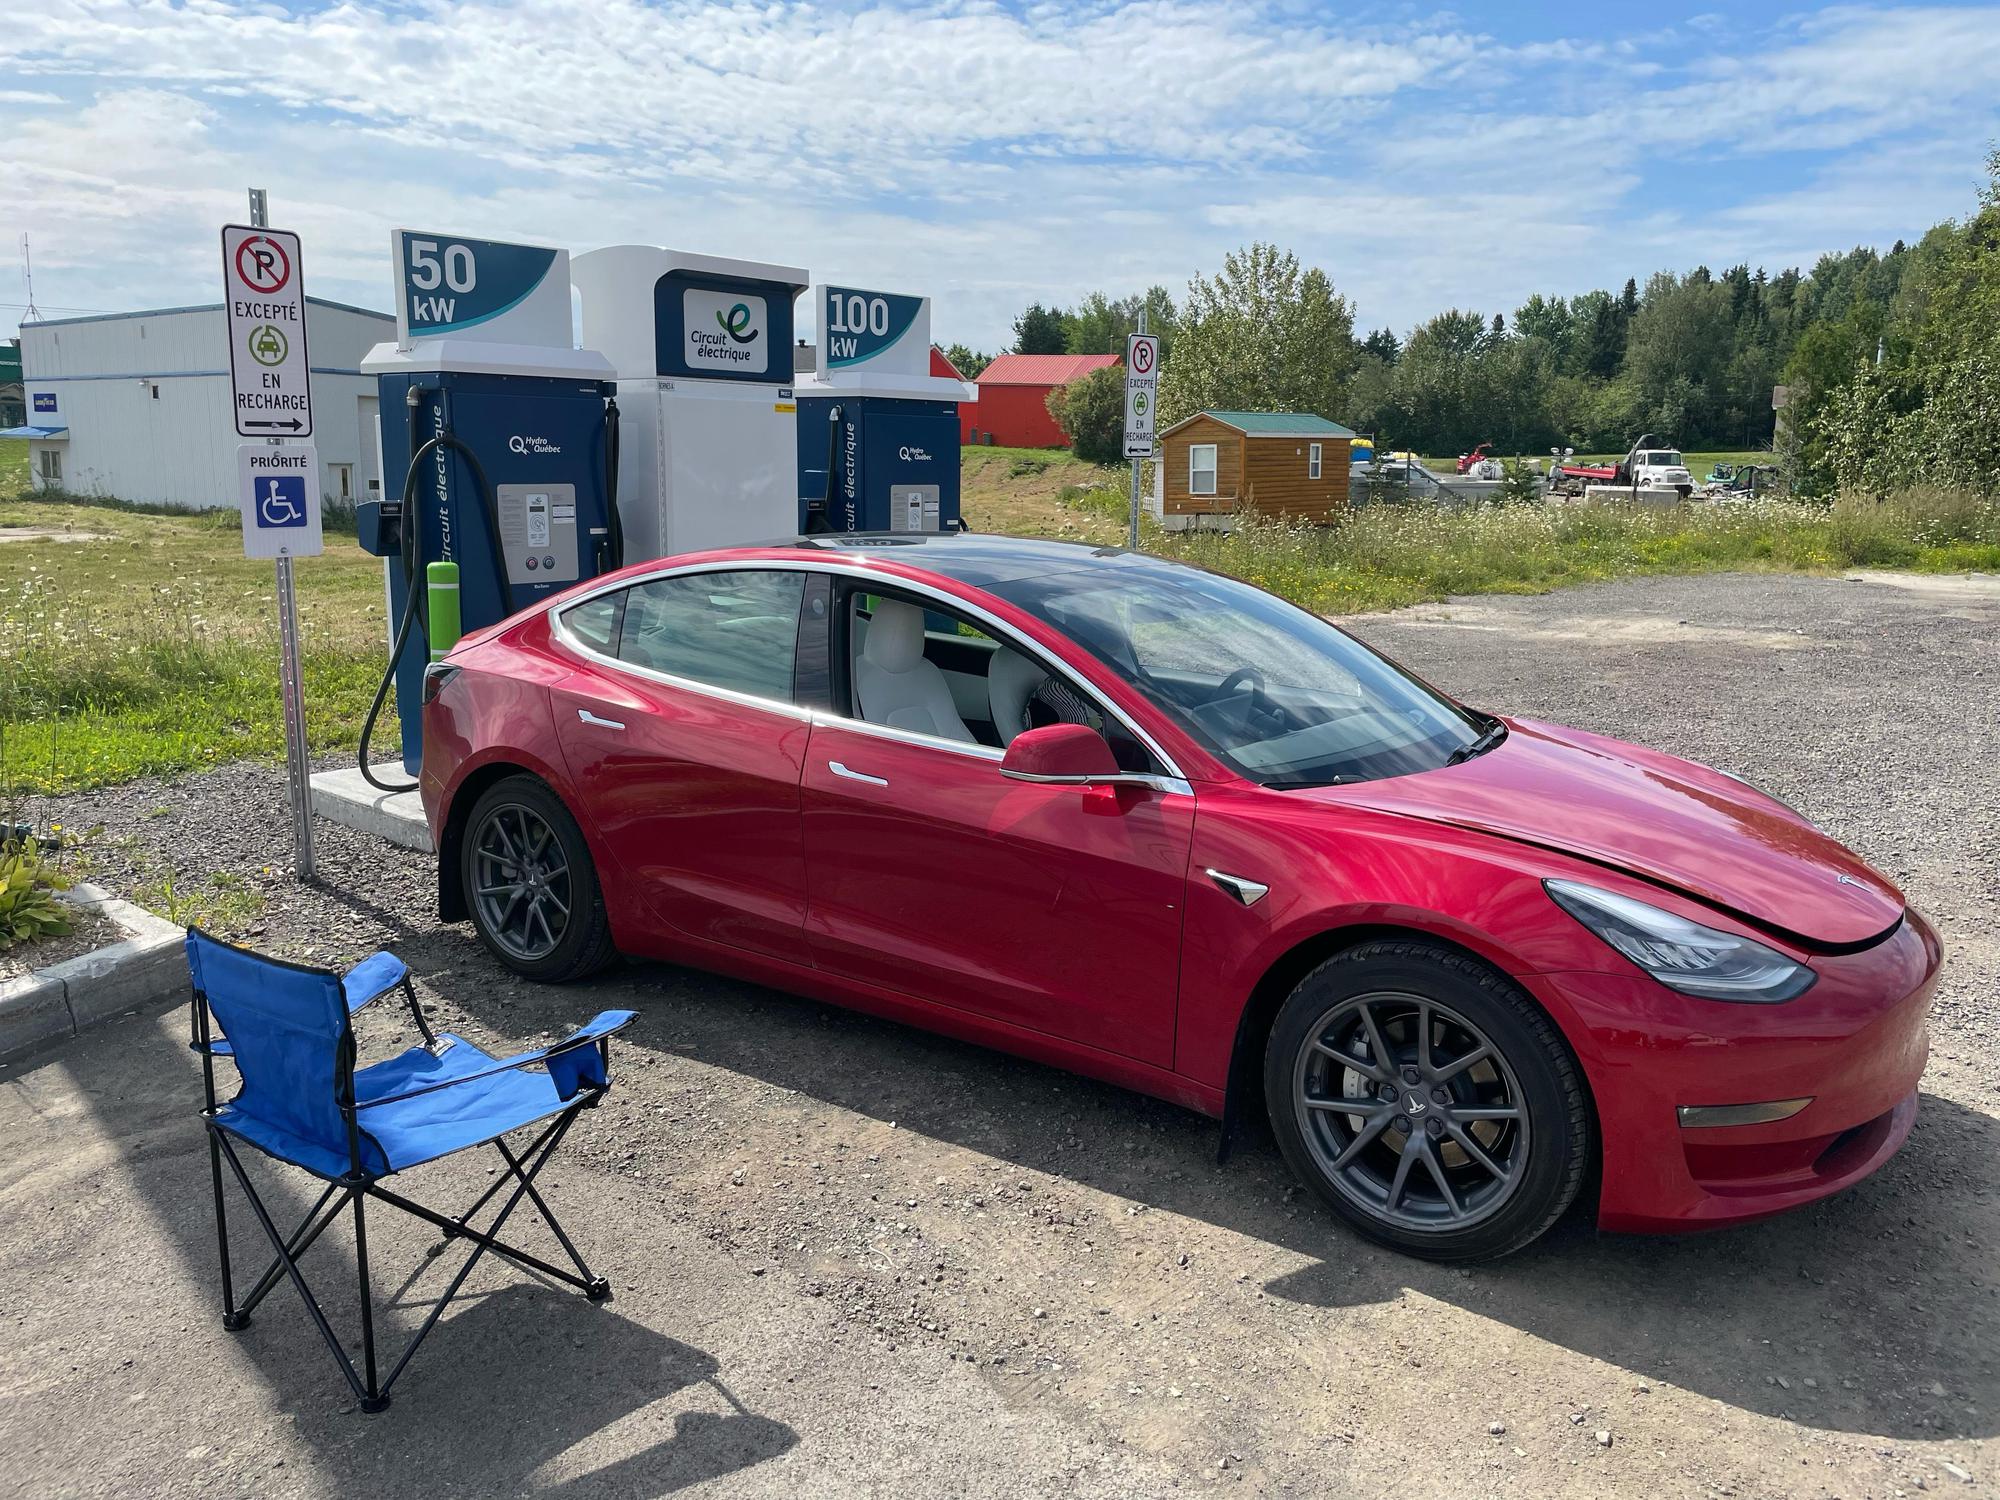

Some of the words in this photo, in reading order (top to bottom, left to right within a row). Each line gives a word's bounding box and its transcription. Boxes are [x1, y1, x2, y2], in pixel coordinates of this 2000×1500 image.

[411, 240, 476, 293] 50
[235, 301, 298, 321] EXCEPTÉ
[413, 295, 455, 322] kW
[831, 294, 889, 336] 100
[691, 330, 727, 345] Circuit
[697, 344, 751, 363] électrique
[831, 336, 858, 358] kW
[262, 373, 281, 388] EN
[1130, 377, 1154, 389] EXCEPTÉ
[238, 393, 307, 410] RECHARGE
[1136, 420, 1144, 429] EN
[525, 436, 548, 446] Hydro
[1125, 432, 1153, 442] RECHARGE
[434, 405, 448, 501] électrque
[534, 444, 561, 453] Québec
[250, 455, 307, 467] PRIORITÉ
[844, 422, 857, 498] électrique
[845, 502, 855, 532] cuit
